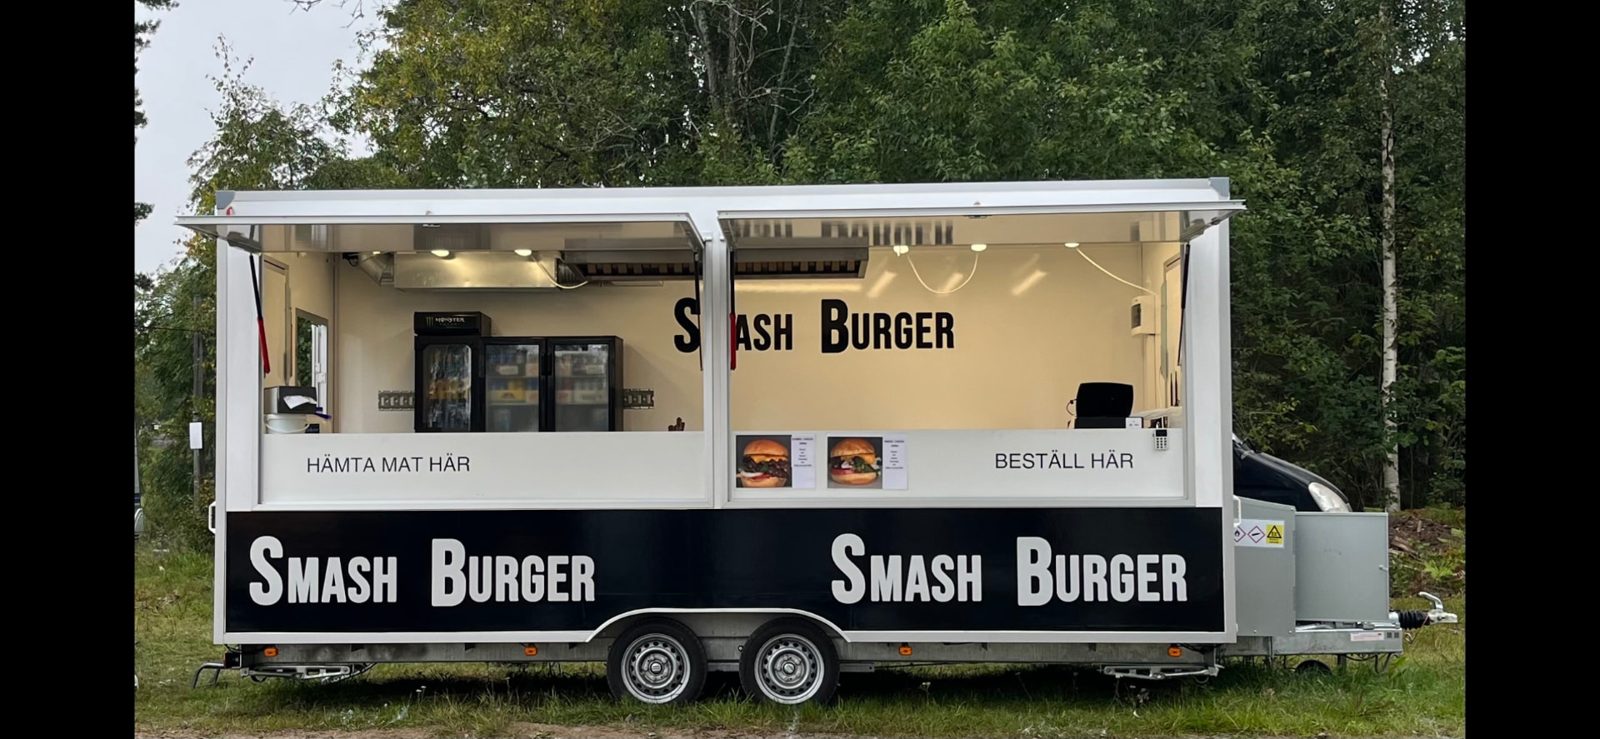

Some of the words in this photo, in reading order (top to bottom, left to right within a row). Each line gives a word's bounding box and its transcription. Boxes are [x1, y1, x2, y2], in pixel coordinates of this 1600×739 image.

[674, 297, 793, 353] SASH
[821, 298, 955, 353] BURGER
[307, 453, 376, 473] HÄMTA
[382, 456, 424, 473] MAT
[429, 452, 470, 472] HÄR
[995, 449, 1085, 470] BESTÄLL
[1091, 449, 1134, 469] HÄR
[249, 535, 397, 606] SMASH
[431, 538, 595, 607] BURGER
[831, 533, 982, 605] SMASH
[1016, 536, 1188, 607] BURGER
